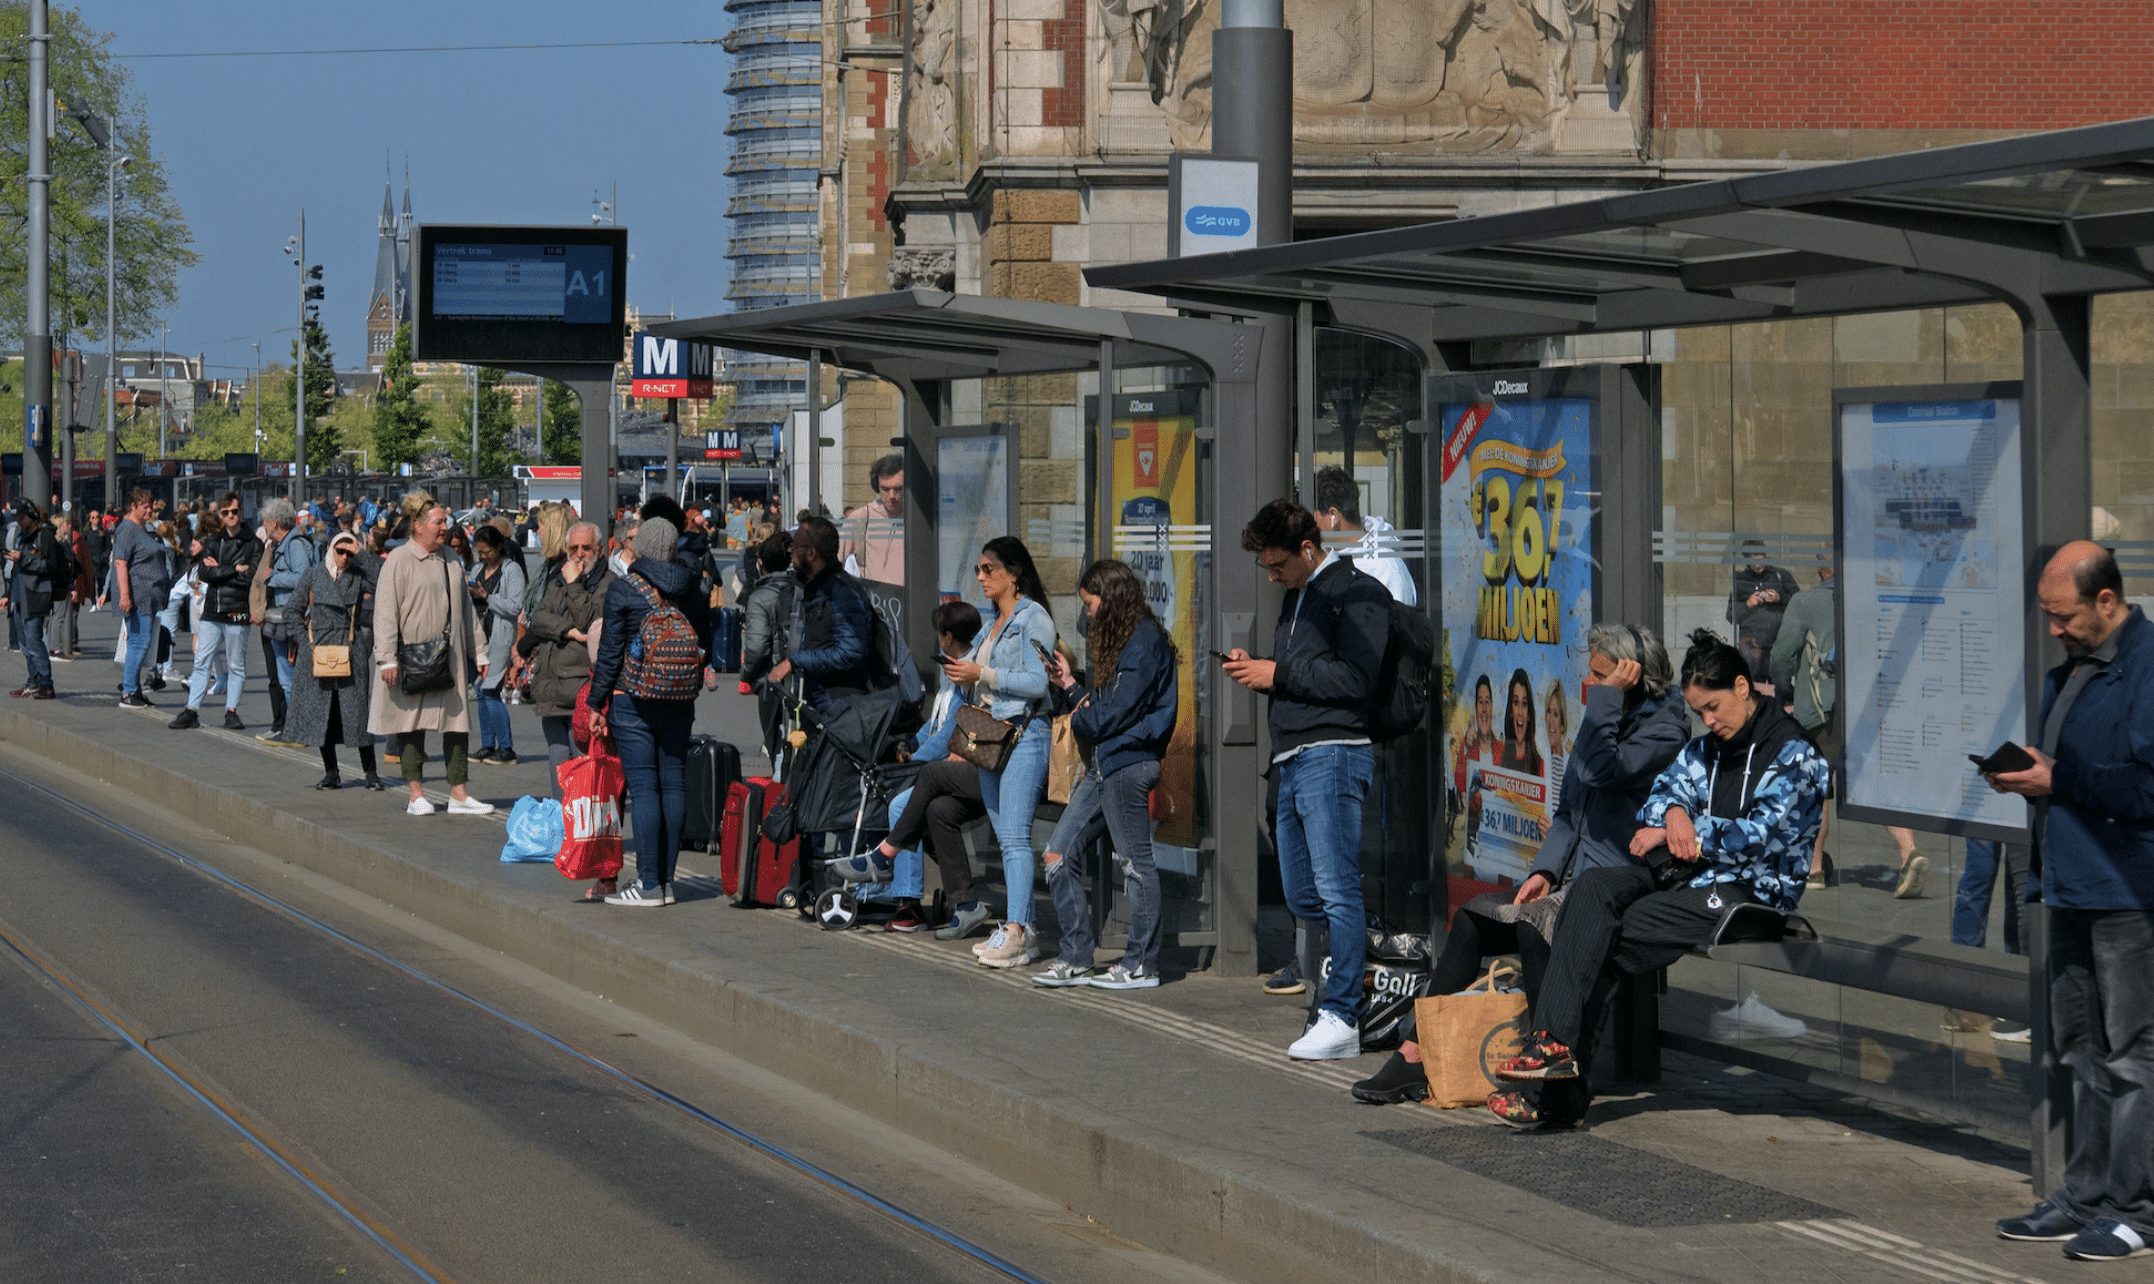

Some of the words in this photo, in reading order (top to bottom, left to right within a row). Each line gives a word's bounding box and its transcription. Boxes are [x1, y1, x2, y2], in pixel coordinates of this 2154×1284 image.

[1218, 217, 1241, 227] GVB
[566, 270, 605, 297] A1
[643, 336, 678, 375] M
[692, 343, 709, 375] M
[1493, 380, 1528, 395] JCDecaux
[708, 431, 718, 448] M
[723, 431, 738, 448] M
[1450, 411, 1476, 462] NIEUW!
[1477, 585, 1560, 645] MILJOEN
[1485, 772, 1541, 799] KONINGSKANJER
[1374, 968, 1416, 996] Gall
